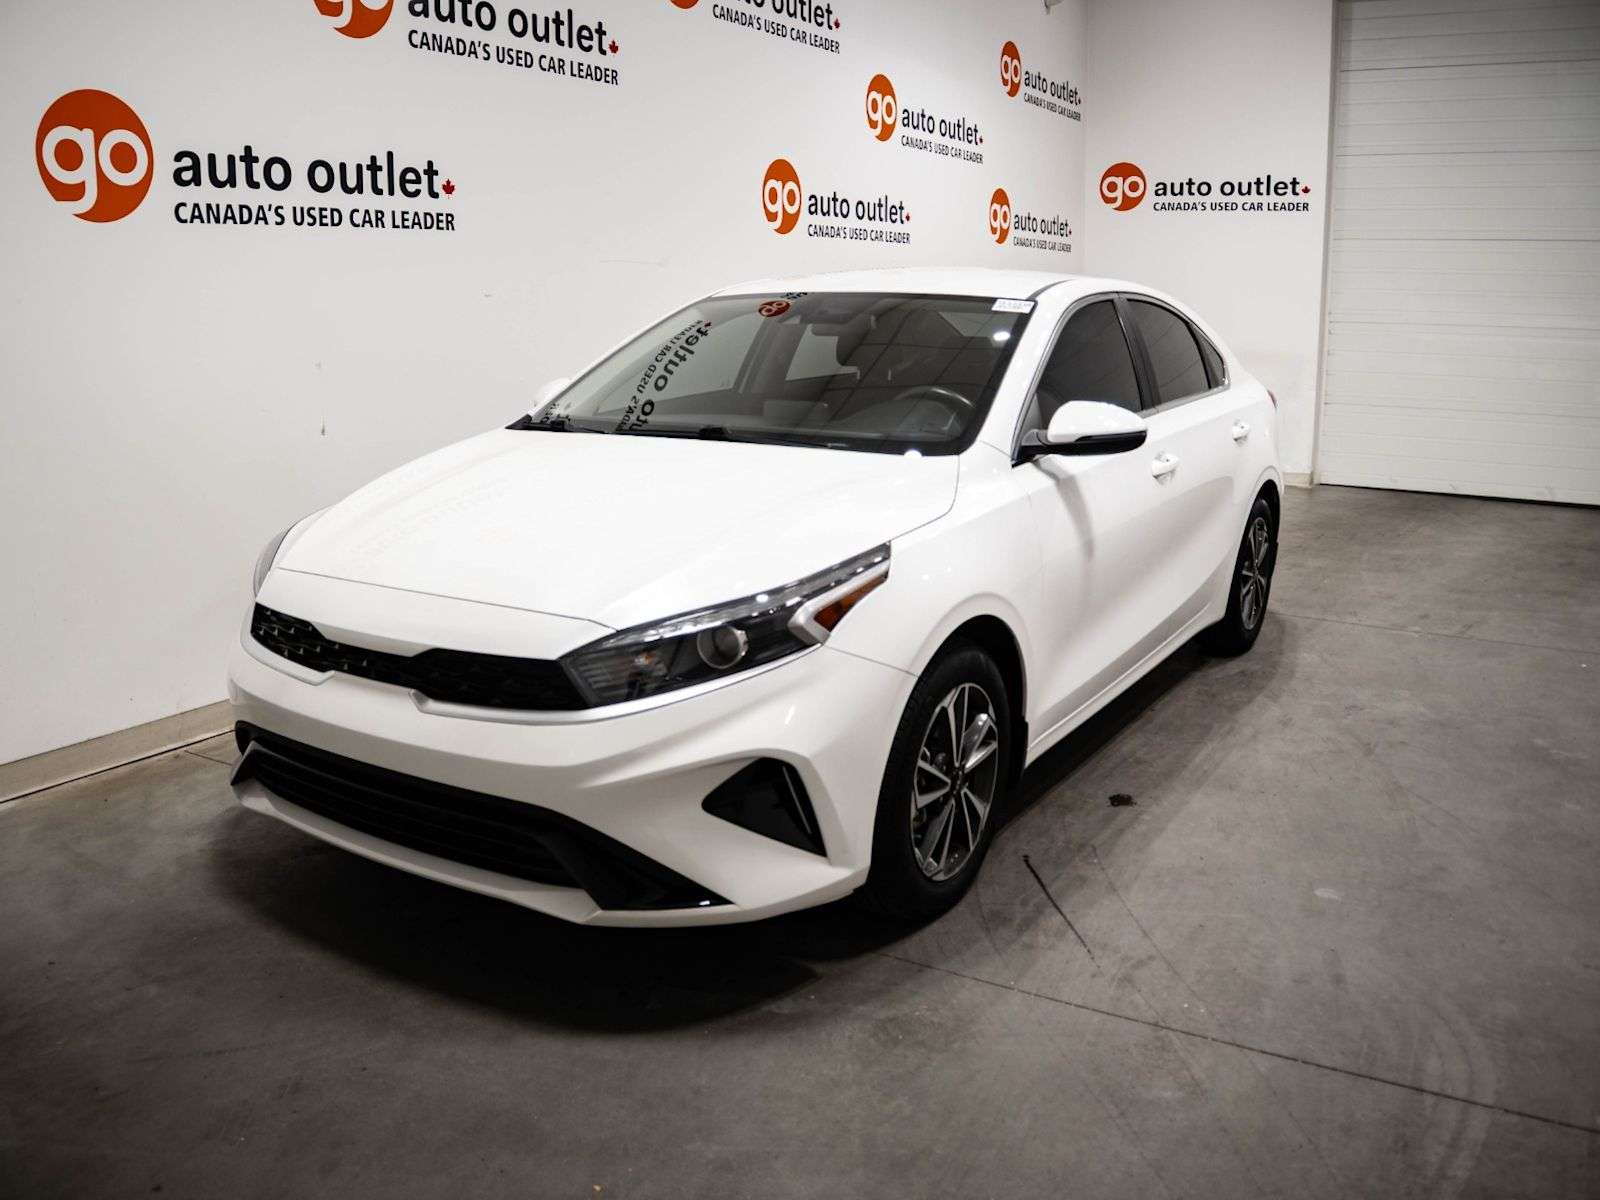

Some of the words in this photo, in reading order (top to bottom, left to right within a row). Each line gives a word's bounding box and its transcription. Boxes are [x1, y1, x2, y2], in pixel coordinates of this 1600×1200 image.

[408, 0, 496, 31] auto
[508, 8, 607, 56] outlet
[713, 4, 761, 31] CANADA'S
[764, 20, 787, 38] USED
[790, 27, 807, 45] CAR
[809, 32, 840, 54] LEADER
[408, 29, 491, 61] CANADA'S
[496, 46, 534, 69] USED
[538, 54, 566, 75] CAR
[570, 60, 619, 86] LEADER
[1024, 70, 1048, 93] auto
[1050, 81, 1078, 106] outlet
[902, 108, 935, 134] auto
[940, 117, 979, 145] outlet
[901, 135, 933, 153] CANADA'S
[934, 142, 950, 156] USED
[950, 147, 962, 159] CAR
[963, 150, 983, 164] LEADER
[43, 125, 149, 216] go
[173, 145, 292, 191] auto
[307, 151, 440, 199] outlet
[1154, 178, 1212, 196] auto
[1220, 174, 1300, 196] outlet
[764, 179, 800, 230] go
[808, 191, 850, 219] auto
[855, 195, 905, 225] outlet
[1102, 175, 1145, 207] go
[1153, 201, 1207, 212] CANADA'S
[1210, 202, 1239, 212] USED
[1242, 202, 1264, 212] CAR
[1267, 202, 1310, 212] LEADER
[174, 202, 286, 226] CANADA'S
[292, 206, 342, 227] USED
[349, 208, 385, 228] CAR
[391, 210, 456, 231] LEADER
[808, 224, 847, 239] CANADA'S
[849, 227, 868, 241] USED
[870, 229, 884, 242] CAR
[885, 231, 911, 244] LEADER
[1014, 212, 1038, 233] auto
[1040, 214, 1068, 238] outlet
